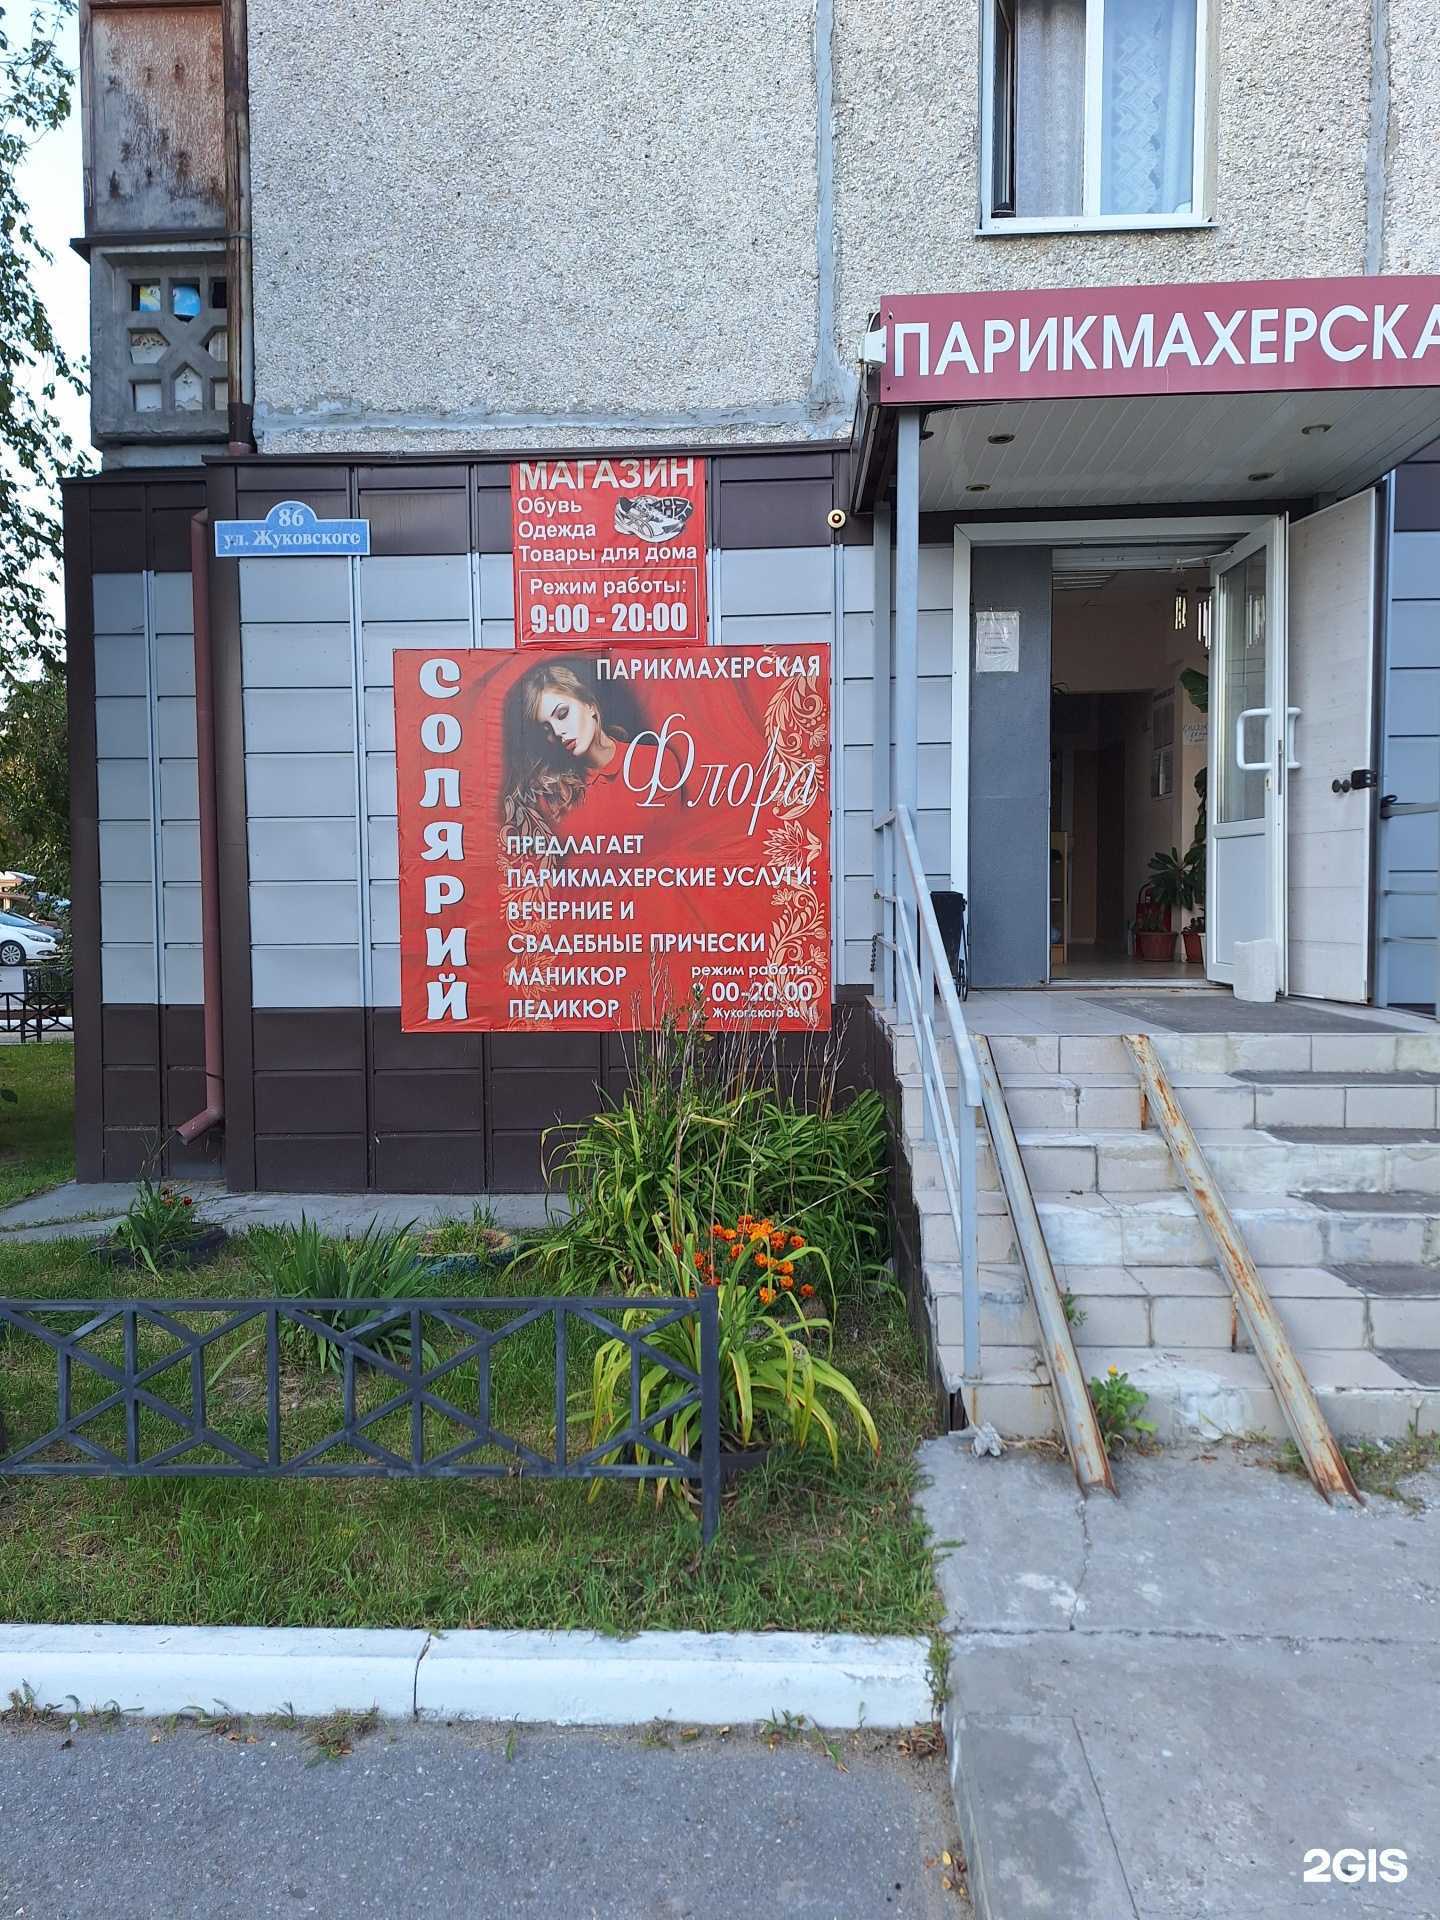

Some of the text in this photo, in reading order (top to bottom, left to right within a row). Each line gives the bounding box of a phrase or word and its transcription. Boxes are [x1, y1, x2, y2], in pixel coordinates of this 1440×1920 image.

[894, 304, 1440, 377] ПАРИКМАХЕРСКА
[519, 458, 693, 491] МАГАЗИН
[517, 496, 582, 517] Обувь
[278, 508, 304, 527] 86
[223, 529, 361, 549] ул. Жуковского
[518, 521, 596, 541] Одежда
[519, 546, 697, 564] Товары для дома
[530, 577, 687, 598] Режим работы:
[530, 603, 590, 634] 9:00
[612, 602, 688, 632] 20:00
[597, 655, 820, 680] ПАРИКМАХЕРСКАЯ
[623, 713, 819, 836] Флора
[419, 658, 467, 1020] СОЛЯРИЙ
[506, 835, 645, 857] ПРЕДЛАГАЕТ
[507, 867, 818, 888] ПАРИКМАХЕРСКИЕ УСЛУГИ:
[508, 901, 635, 920] ВЕЧЕРНИЕ И
[508, 933, 765, 955] СВАДЕБНЫЕ ПРИЧЕСКИ
[508, 966, 628, 986] МАНИКЮР
[691, 966, 745, 978] режим
[509, 999, 620, 1020] ПЕДИКЮР
